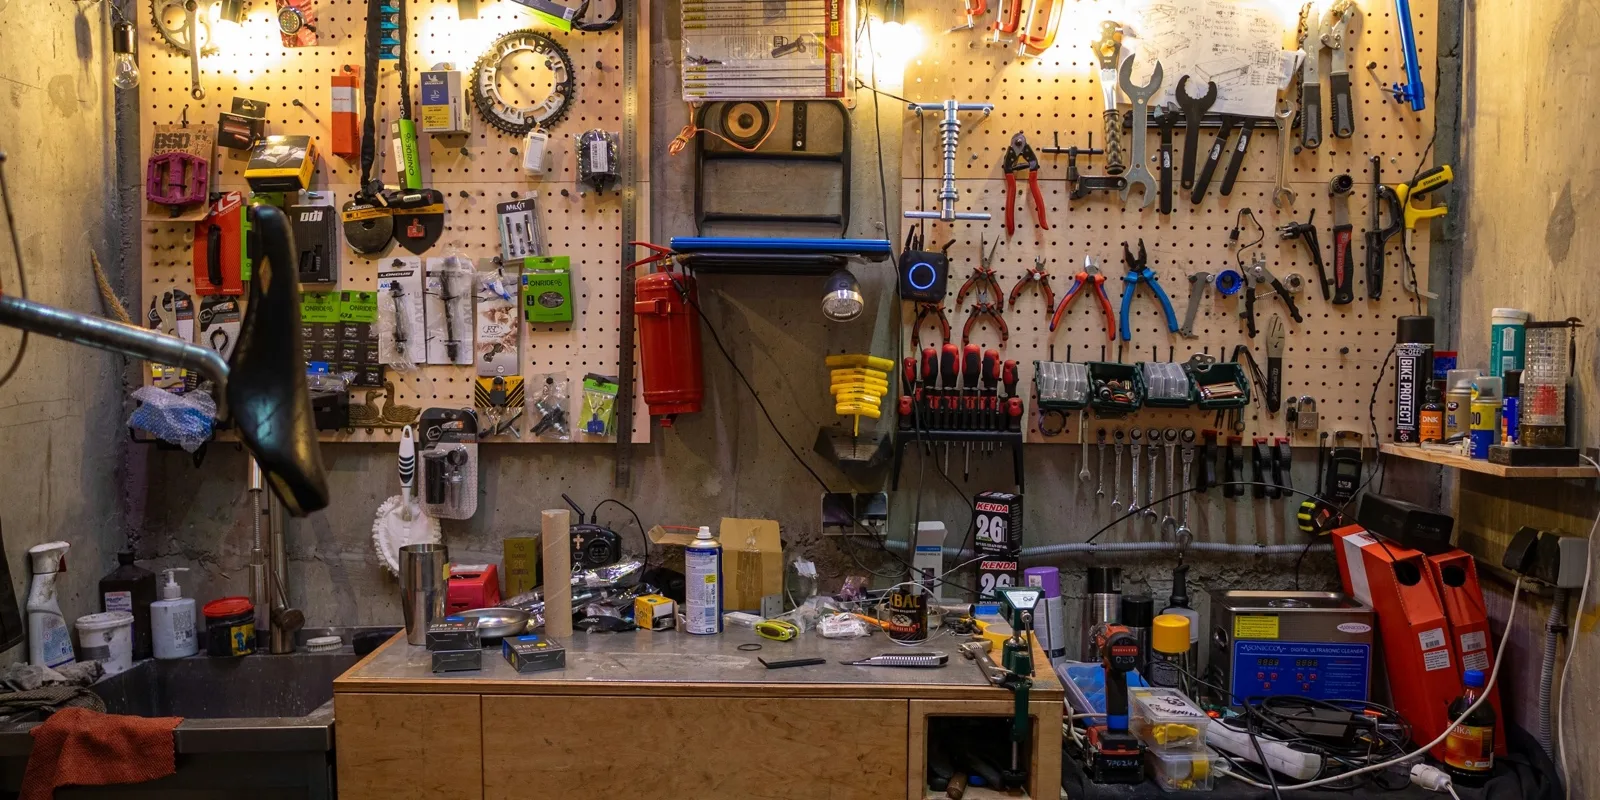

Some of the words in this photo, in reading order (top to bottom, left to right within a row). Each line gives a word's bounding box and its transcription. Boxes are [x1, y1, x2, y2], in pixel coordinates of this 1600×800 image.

[154, 132, 191, 149] BSD
[1422, 175, 1442, 186] STANLEY
[529, 279, 555, 287] ONRIDE
[1401, 359, 1412, 380] BIKE
[1399, 382, 1412, 423] PROTECT
[975, 501, 1009, 513] KENDA
[976, 513, 1003, 543] 26
[980, 560, 1017, 571] KENDA
